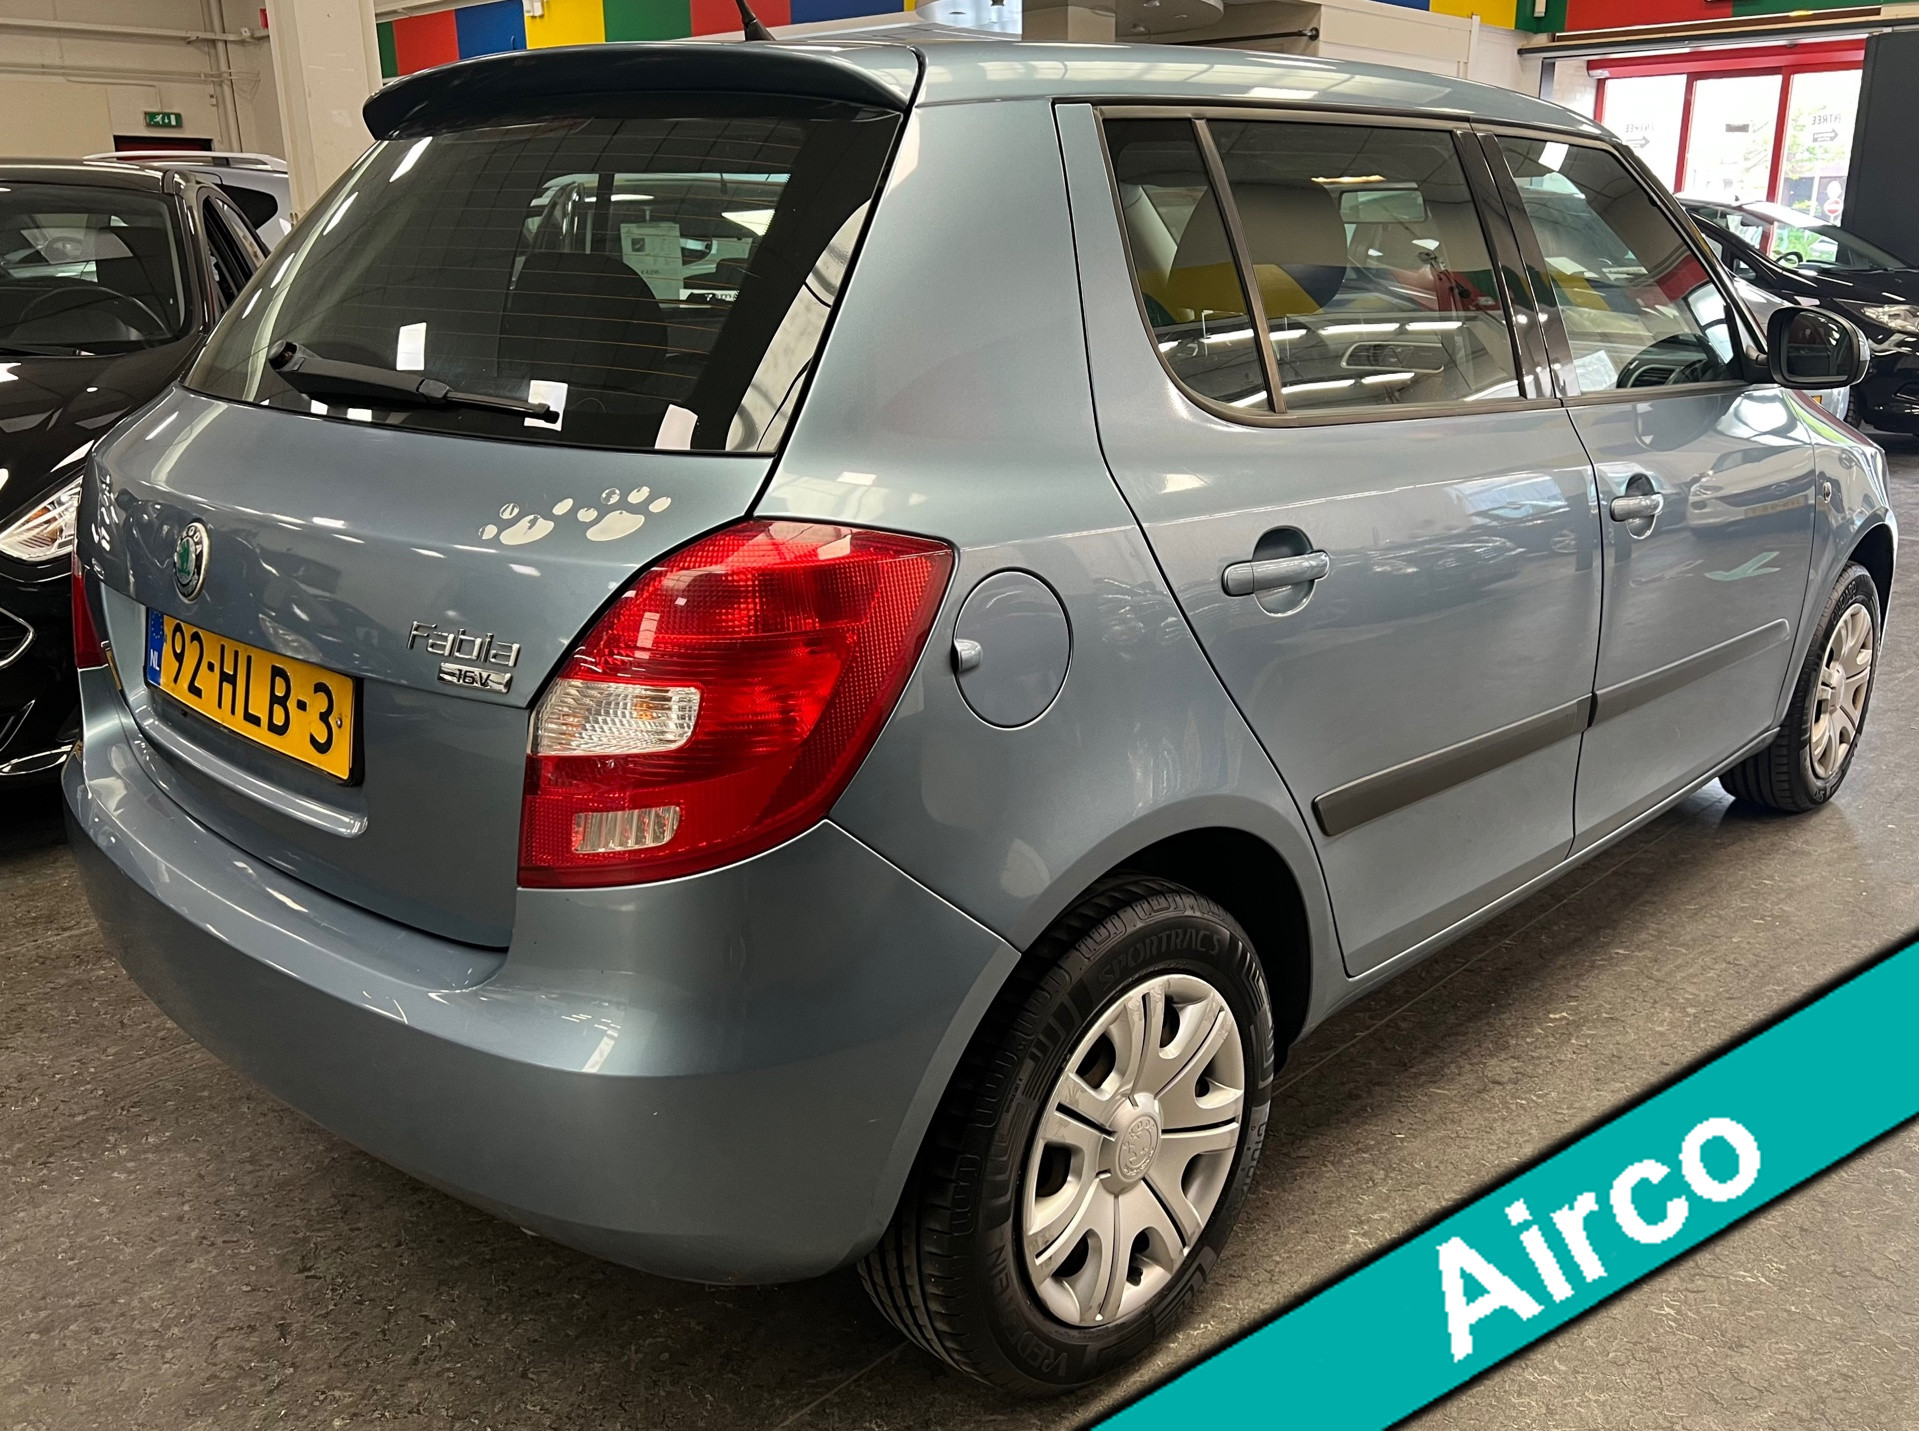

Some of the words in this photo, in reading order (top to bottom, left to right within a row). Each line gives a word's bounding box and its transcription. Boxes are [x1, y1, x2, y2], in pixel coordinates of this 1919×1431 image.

[149, 648, 160, 671] NL
[405, 620, 520, 667] Fabia
[171, 621, 335, 755] 92-HLB-3
[456, 668, 491, 688] 16V
